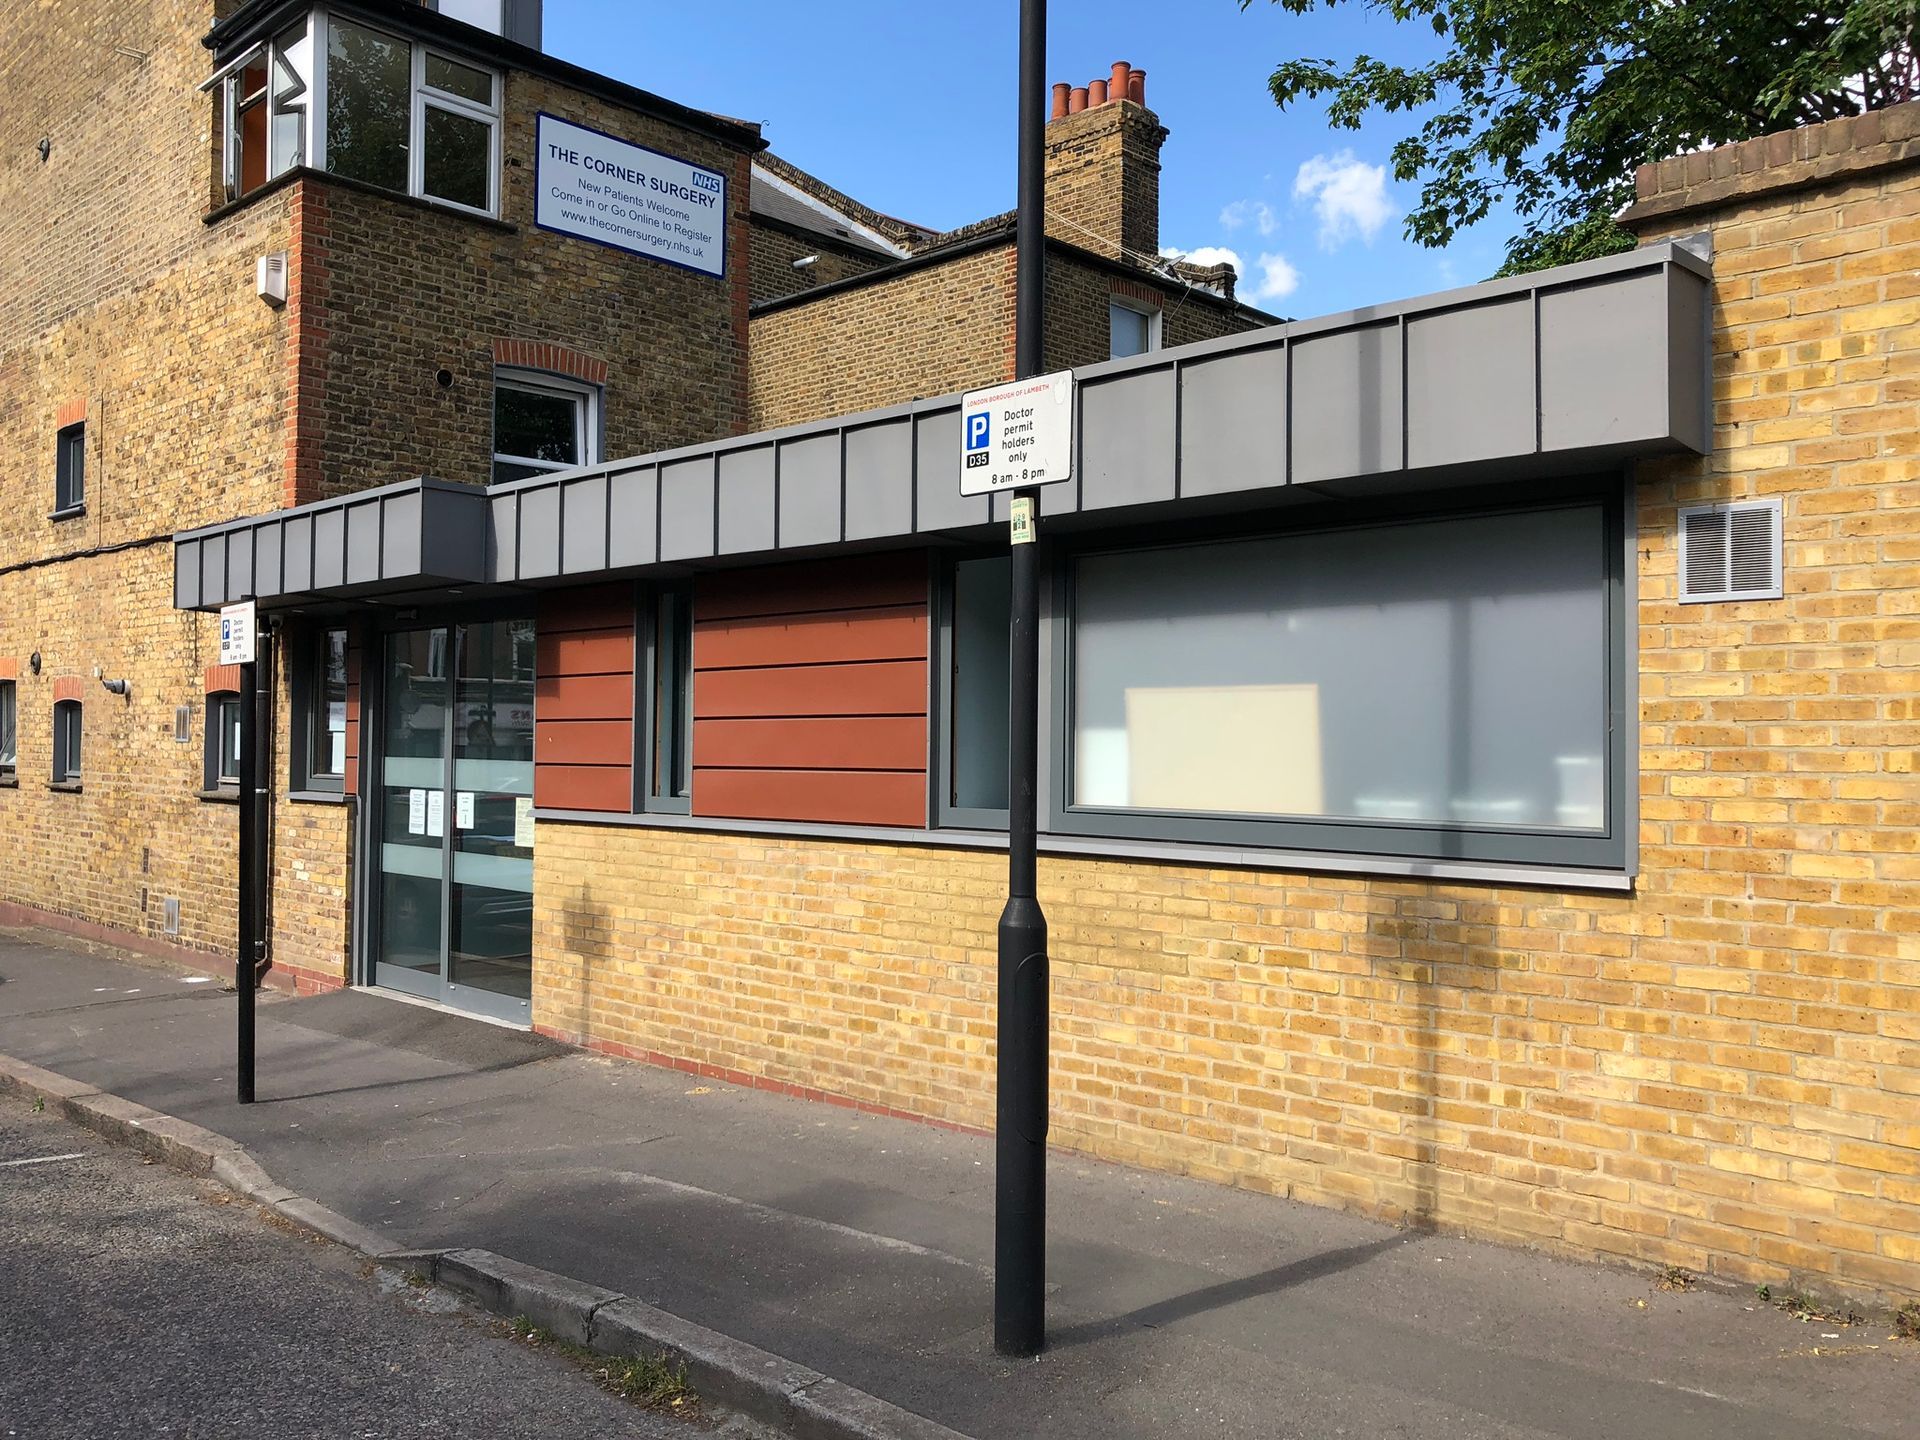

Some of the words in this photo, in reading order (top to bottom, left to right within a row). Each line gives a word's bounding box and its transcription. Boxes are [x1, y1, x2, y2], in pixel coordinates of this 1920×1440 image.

[548, 144, 579, 166] THE
[584, 156, 646, 187] CORNER
[650, 177, 716, 208] SURGERY
[693, 172, 719, 192] NHS
[578, 178, 601, 194] New
[604, 186, 644, 207] Patients
[647, 199, 690, 221] Welcome
[551, 187, 583, 204] Come
[585, 197, 595, 209] in
[597, 202, 608, 212] or
[611, 204, 626, 217] Go
[629, 209, 660, 228] Online
[662, 221, 672, 231] to
[674, 223, 712, 243] Register
[561, 209, 704, 258] www.thecornersurgery.nhs.uk
[967, 398, 988, 407] LONDON
[989, 391, 1015, 402] BOROUGH
[1015, 389, 1023, 397] OF
[1023, 384, 1050, 395] LAMBETH
[1004, 408, 1034, 421] Doctor
[971, 416, 987, 448] P
[1004, 420, 1033, 437] permit
[1002, 436, 1035, 450] holders
[969, 453, 987, 467] D35
[1009, 450, 1028, 463] only
[991, 474, 998, 485] 8
[1000, 473, 1013, 483] am
[1022, 468, 1028, 480] 8
[1031, 468, 1045, 480] pm
